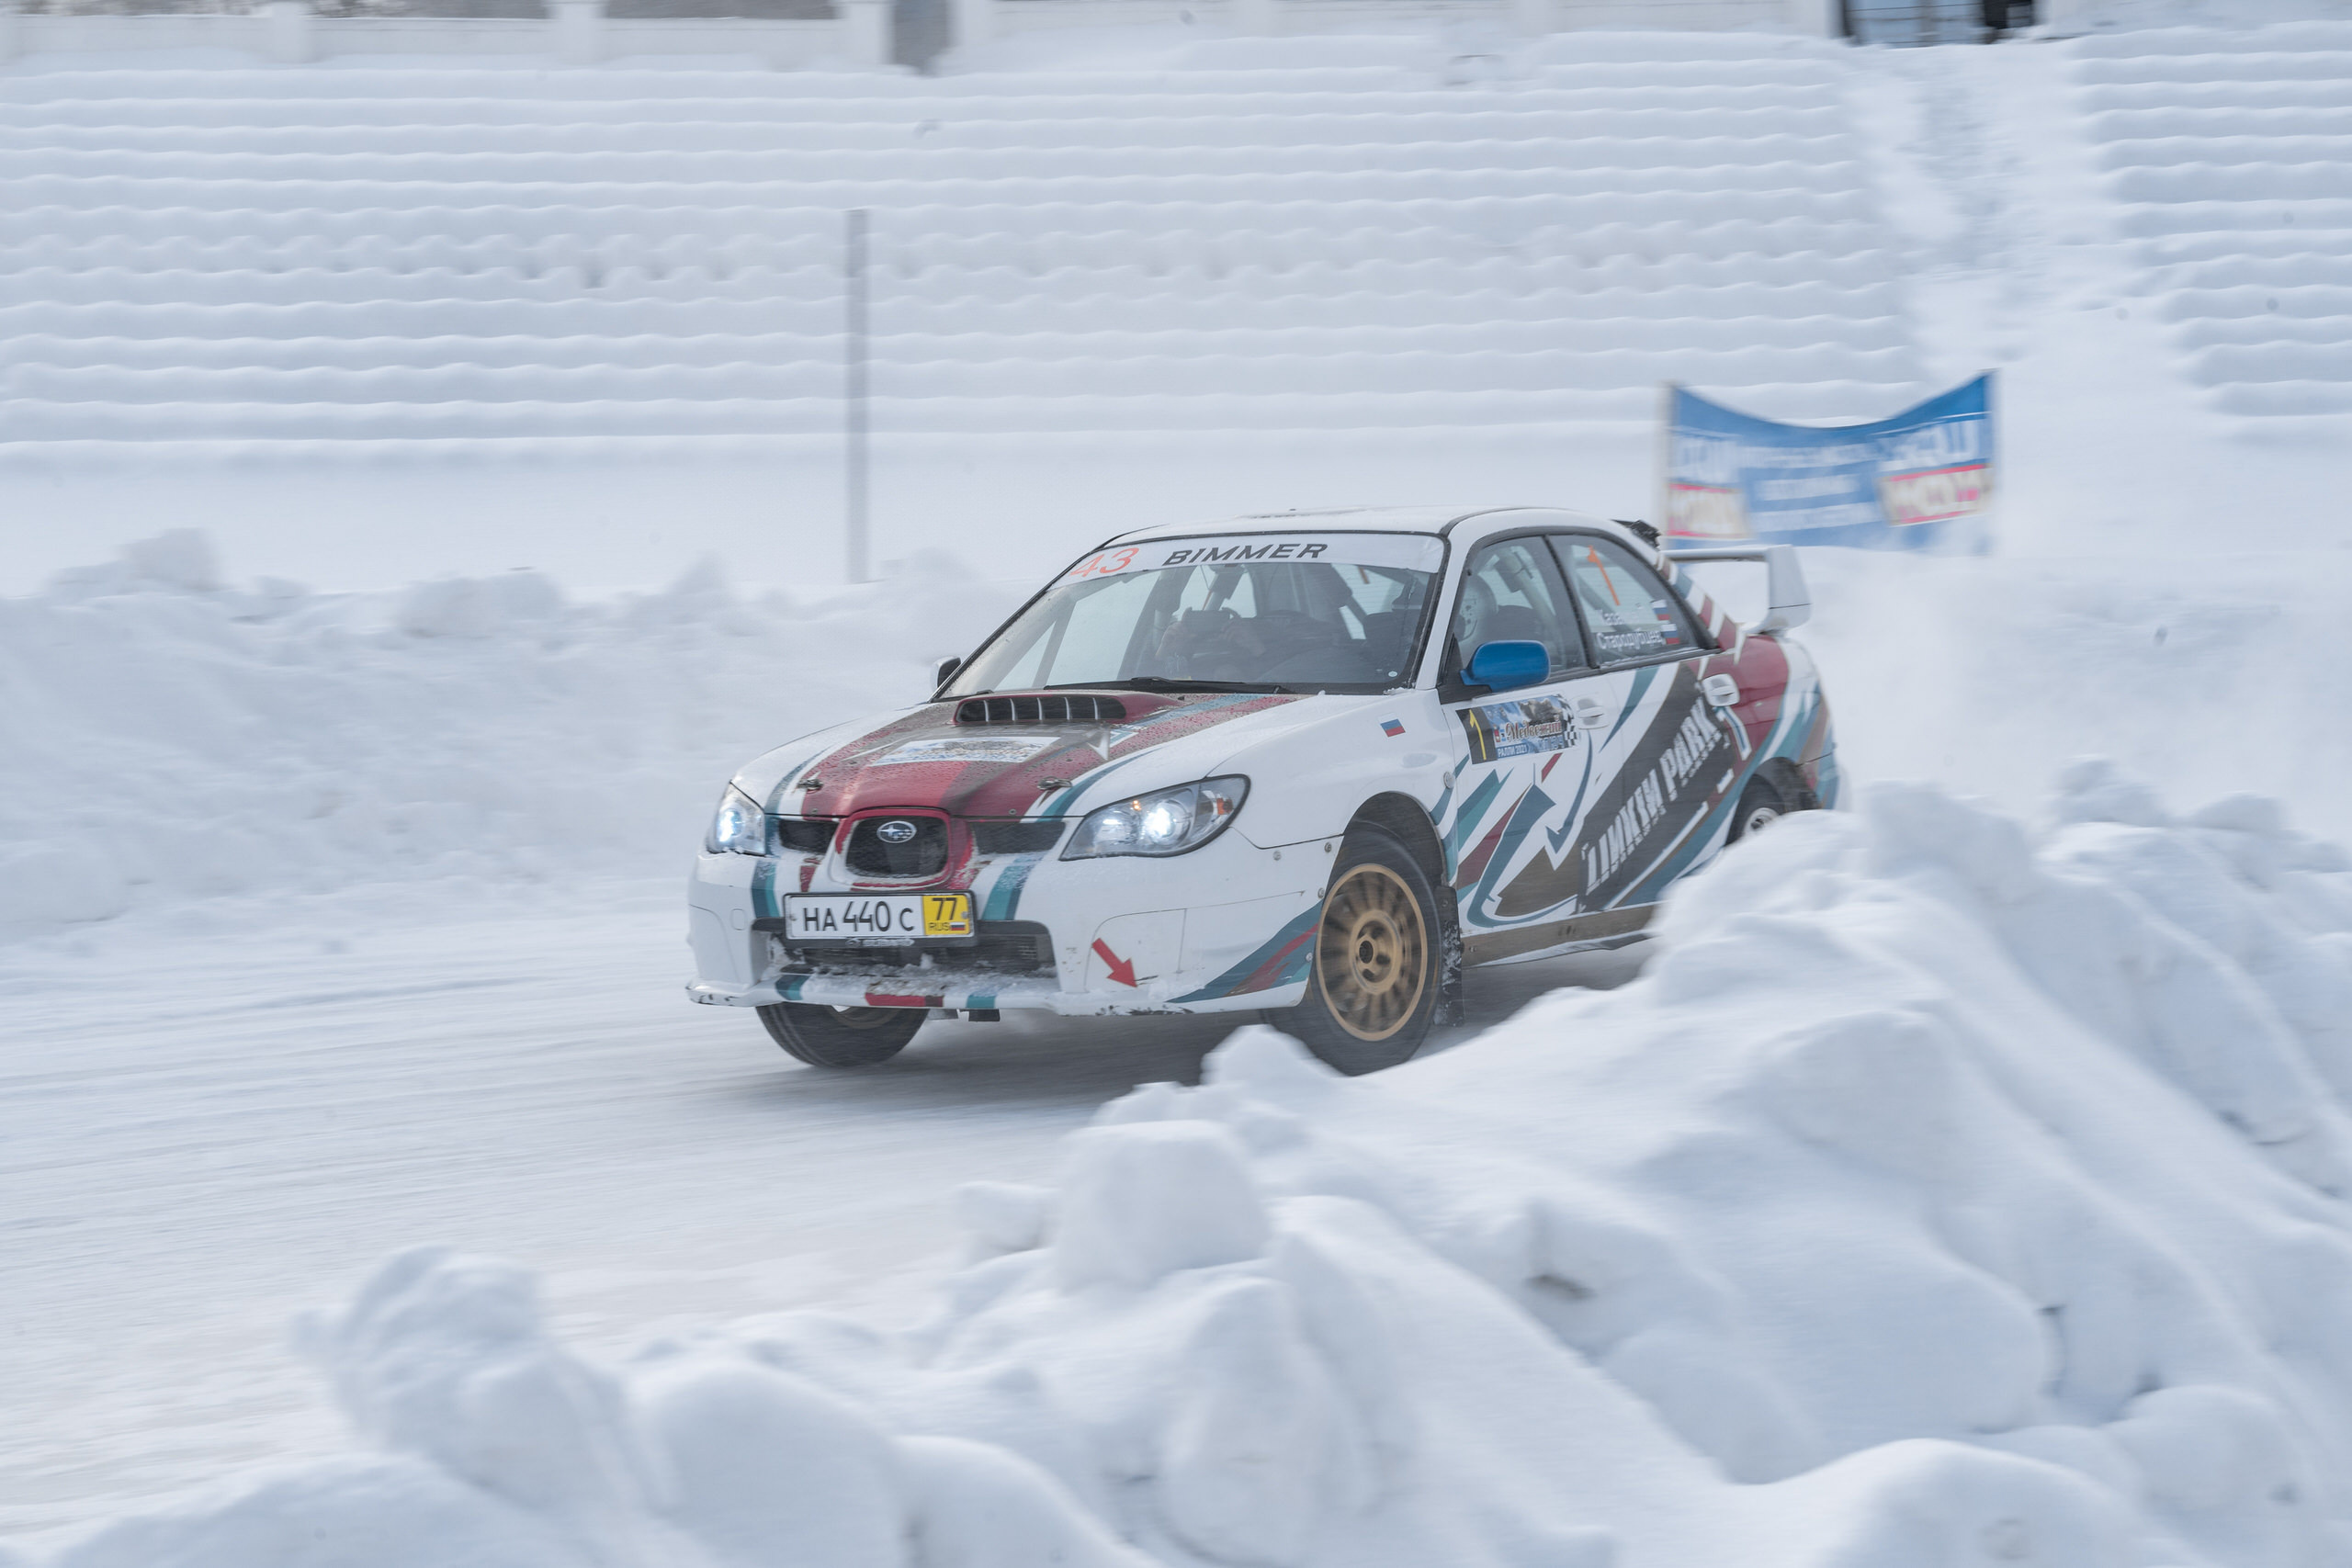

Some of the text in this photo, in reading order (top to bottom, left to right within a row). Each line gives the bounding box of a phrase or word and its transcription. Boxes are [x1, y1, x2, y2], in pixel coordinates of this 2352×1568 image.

[1069, 543, 1329, 578] 43 BIMMER
[1470, 710, 1487, 761] 1
[1658, 696, 1723, 802] PARK
[928, 922, 950, 931] RUS
[933, 897, 957, 921] 77
